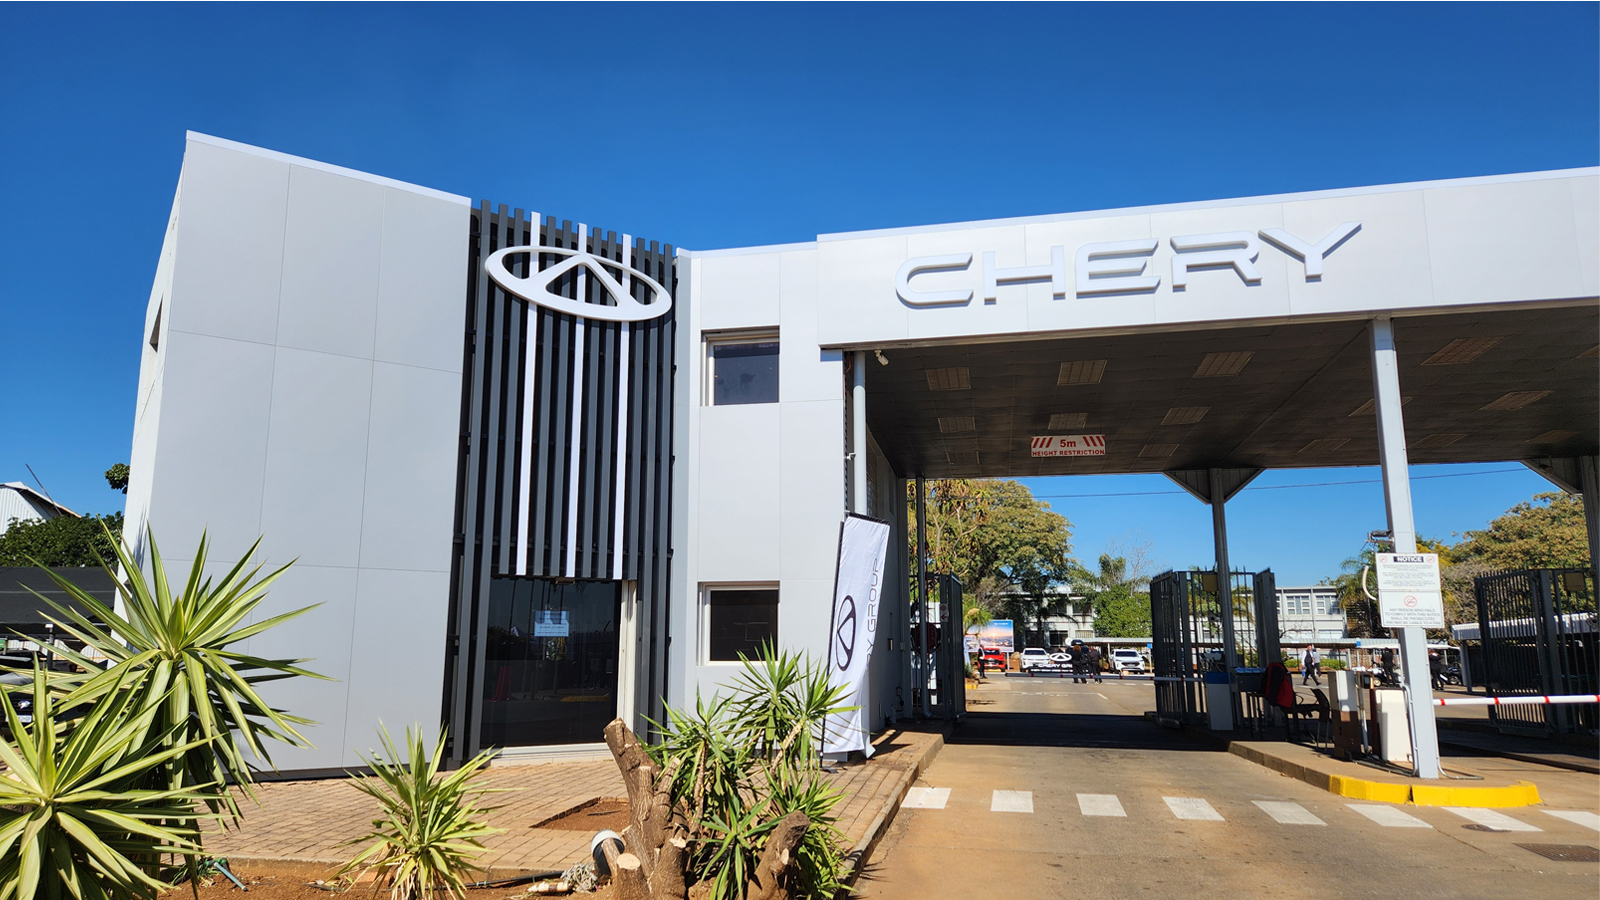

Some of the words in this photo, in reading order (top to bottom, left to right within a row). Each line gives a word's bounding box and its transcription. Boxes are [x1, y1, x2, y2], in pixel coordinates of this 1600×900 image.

[895, 221, 1363, 309] CHERY
[1060, 439, 1076, 447] 5m
[867, 558, 879, 632] GROUP
